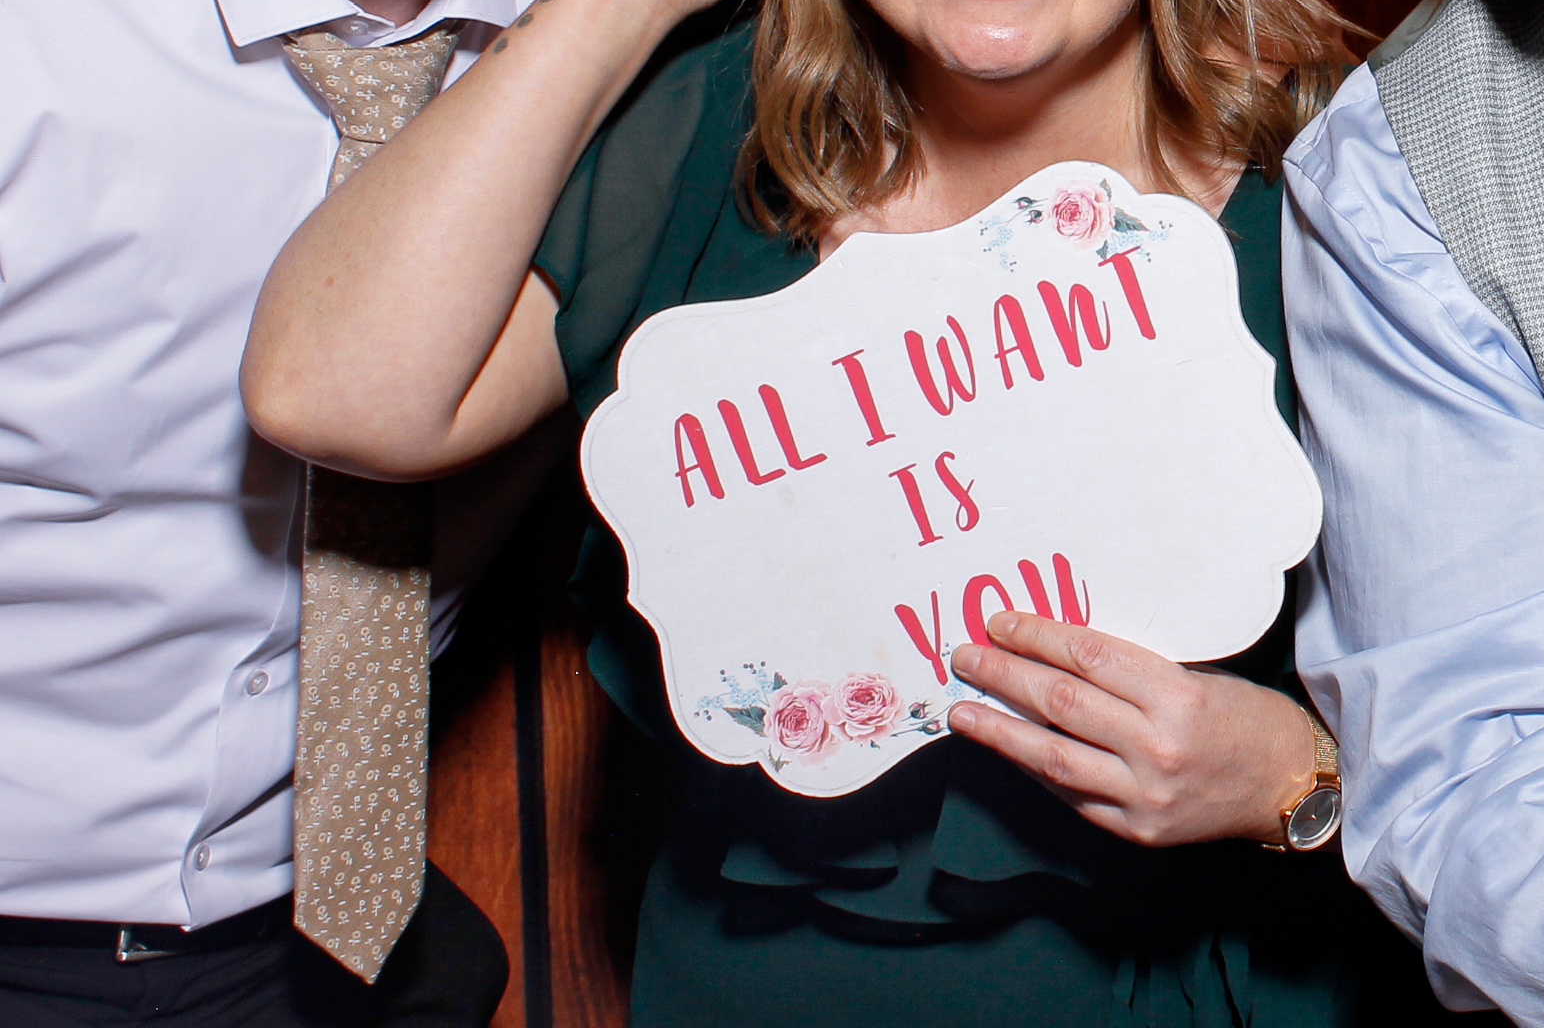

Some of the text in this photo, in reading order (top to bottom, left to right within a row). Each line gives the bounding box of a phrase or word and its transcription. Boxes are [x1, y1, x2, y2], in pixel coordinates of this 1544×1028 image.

[673, 245, 1157, 508] ALL I WANT
[888, 450, 981, 547] IS
[894, 552, 1091, 686] YOU
